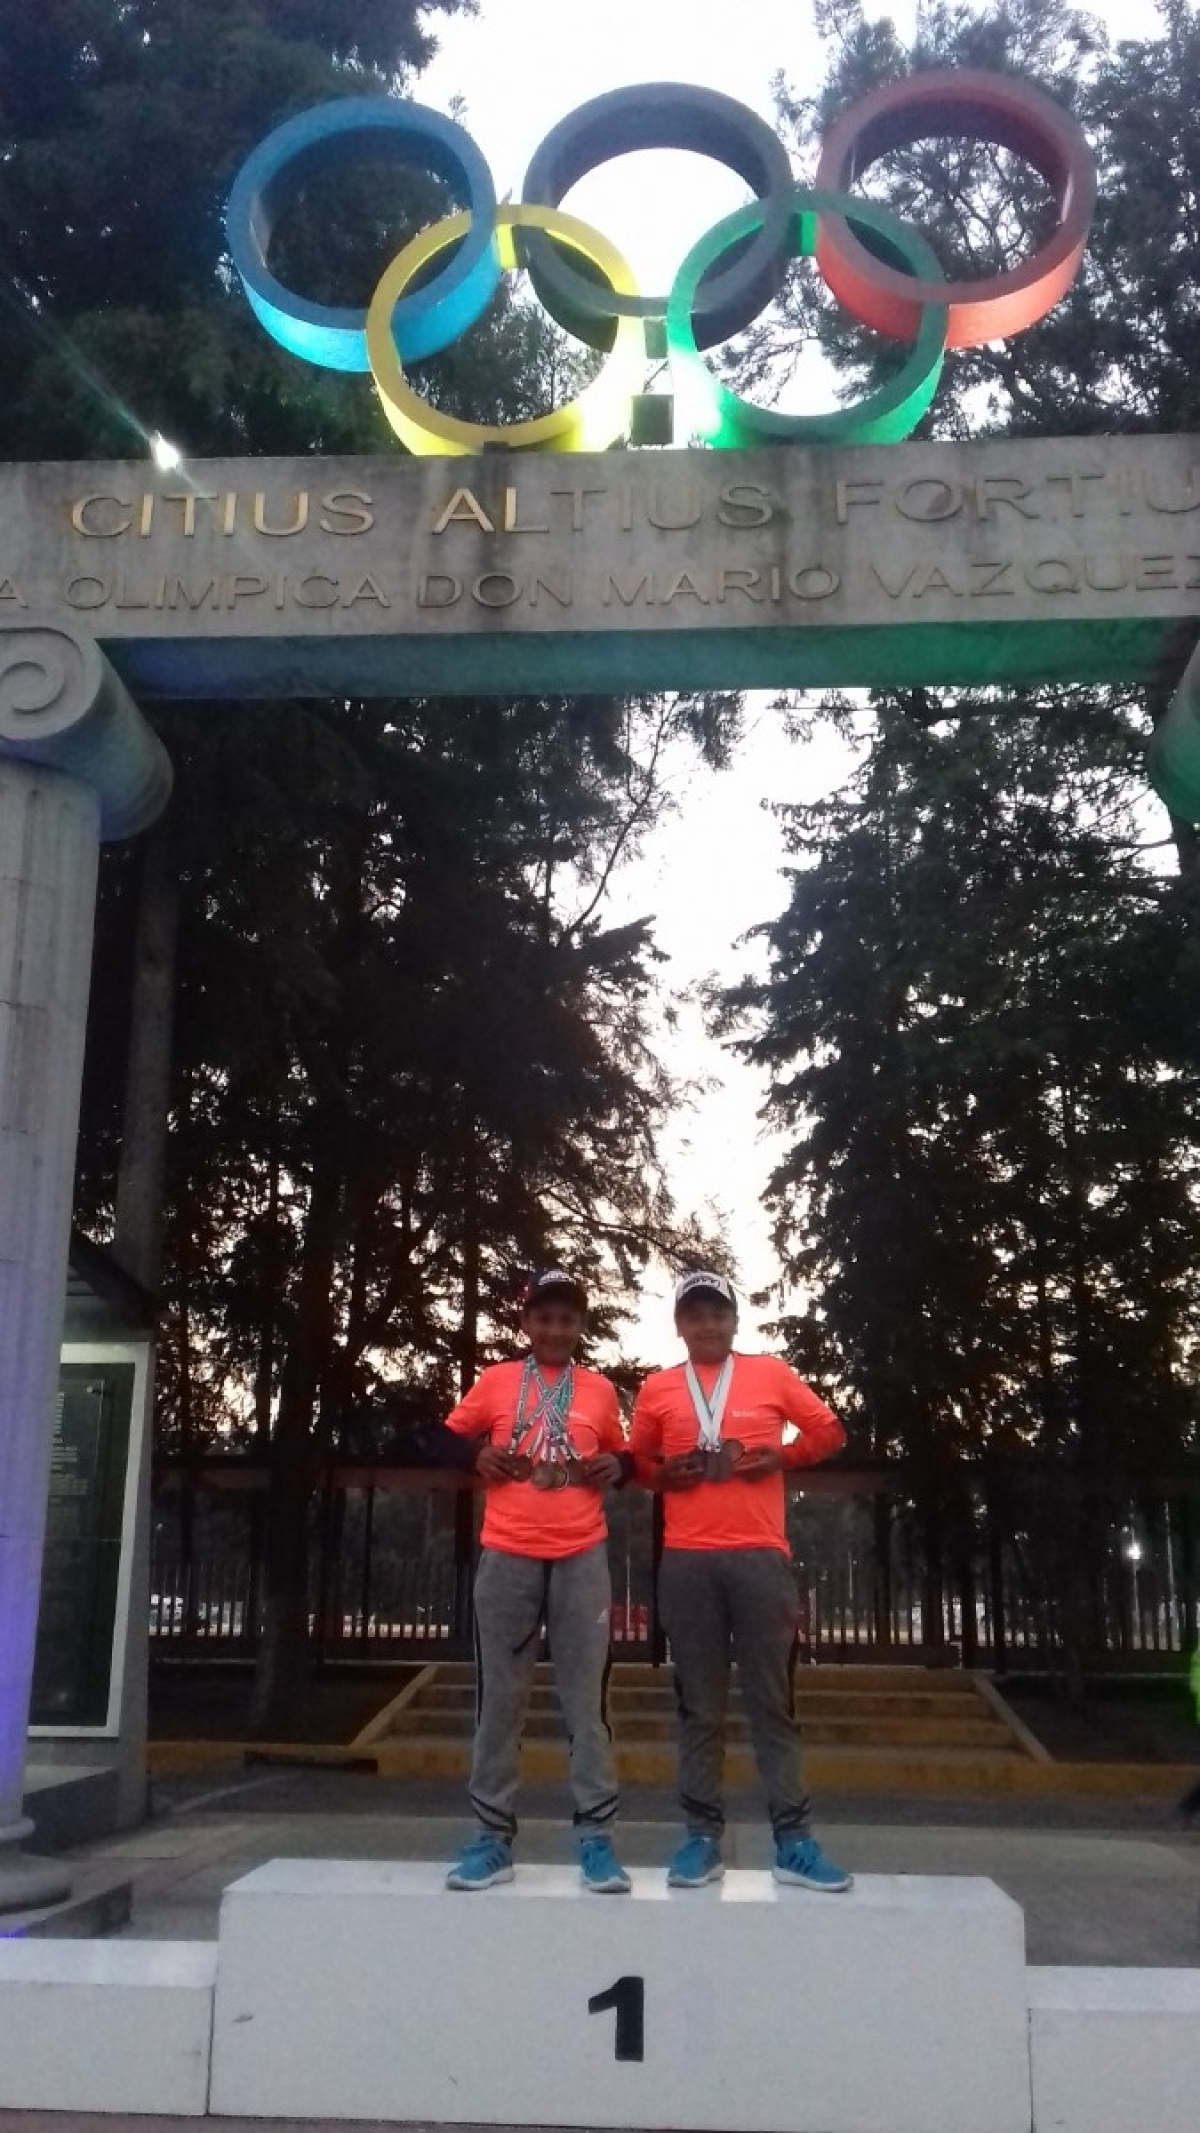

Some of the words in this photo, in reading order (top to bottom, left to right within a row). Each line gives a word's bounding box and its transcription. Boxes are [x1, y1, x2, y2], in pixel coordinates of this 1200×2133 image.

[71, 490, 375, 538] CITIUS
[431, 481, 775, 535] ALTIUS
[62, 572, 391, 610] OLIMPICA
[416, 569, 574, 608] DON
[602, 562, 841, 606] MARIO
[587, 1975, 645, 2063] 1
